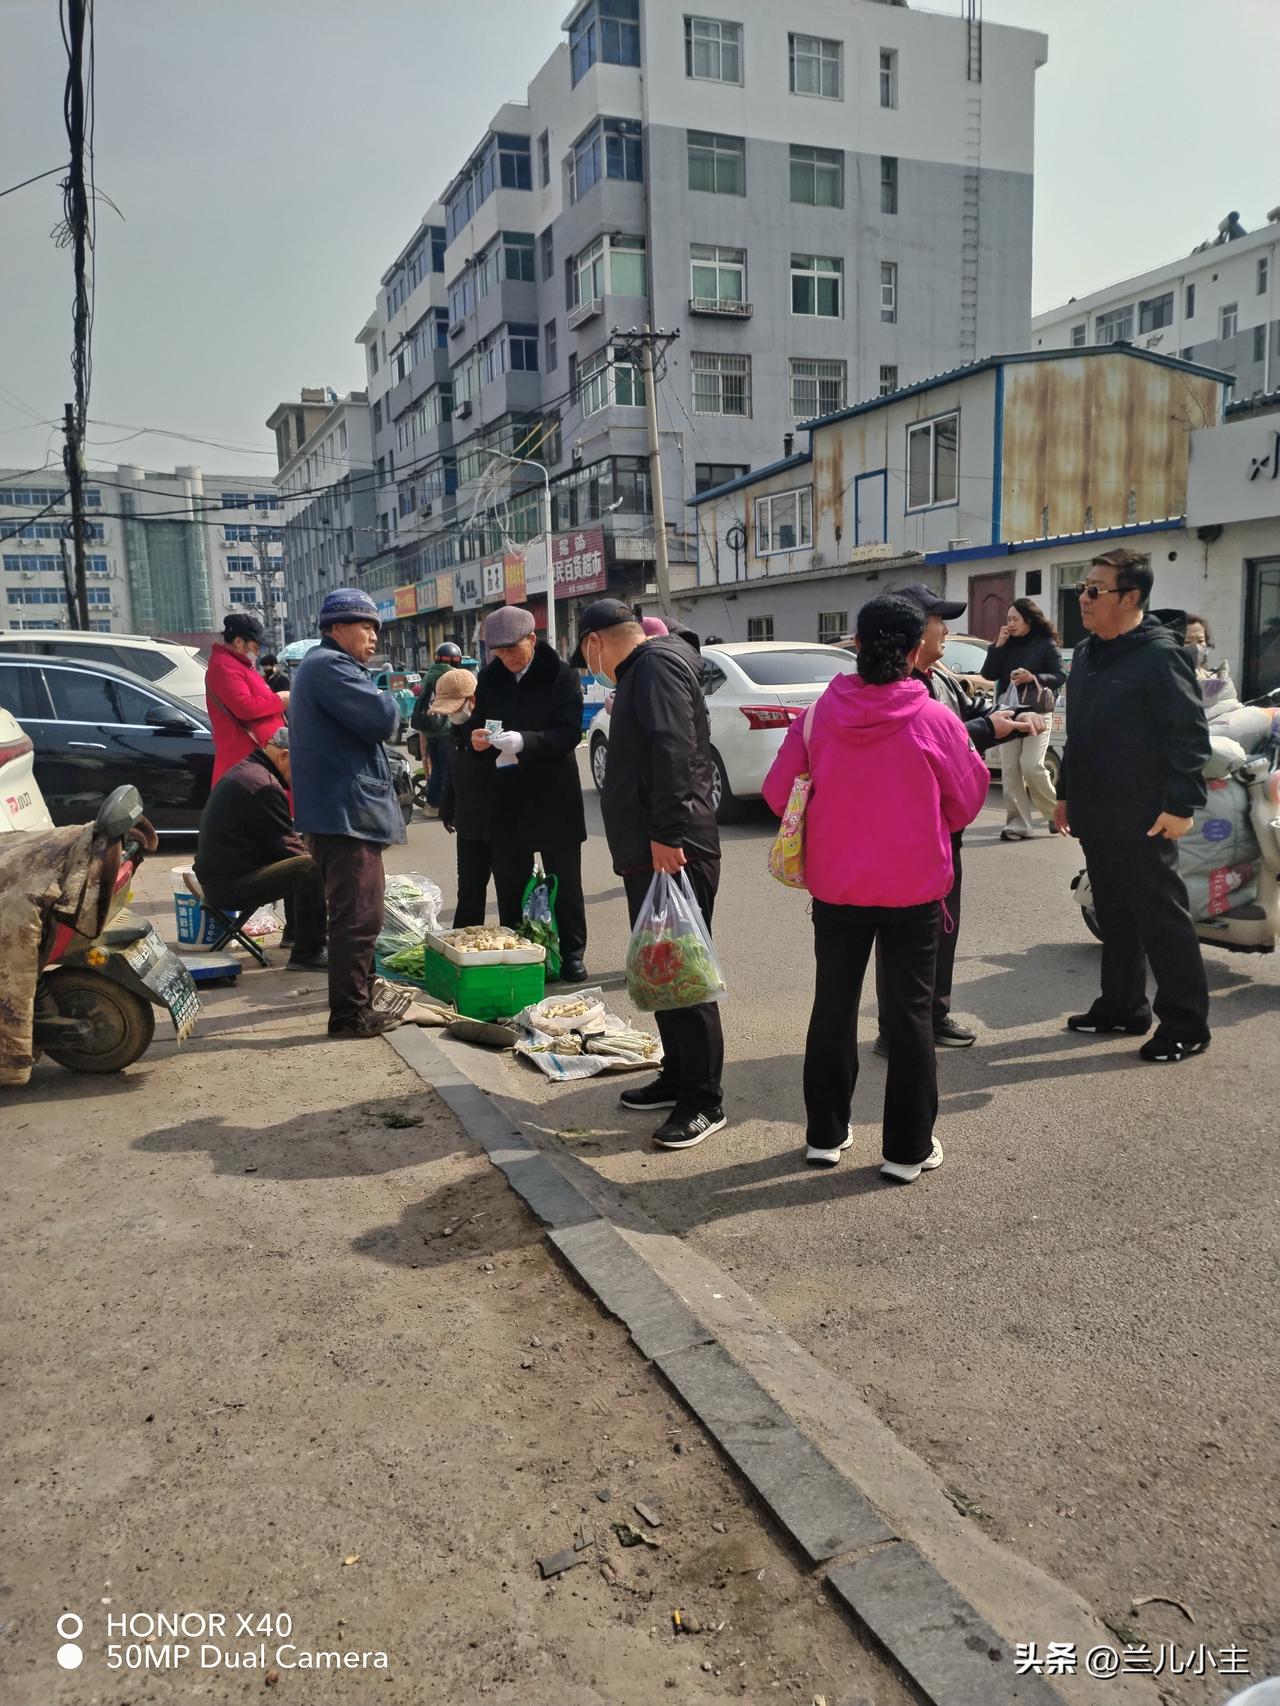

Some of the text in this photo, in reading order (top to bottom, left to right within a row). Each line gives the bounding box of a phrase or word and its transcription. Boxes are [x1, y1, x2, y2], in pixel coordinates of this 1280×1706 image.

[553, 550, 602, 585] 民百货超市
